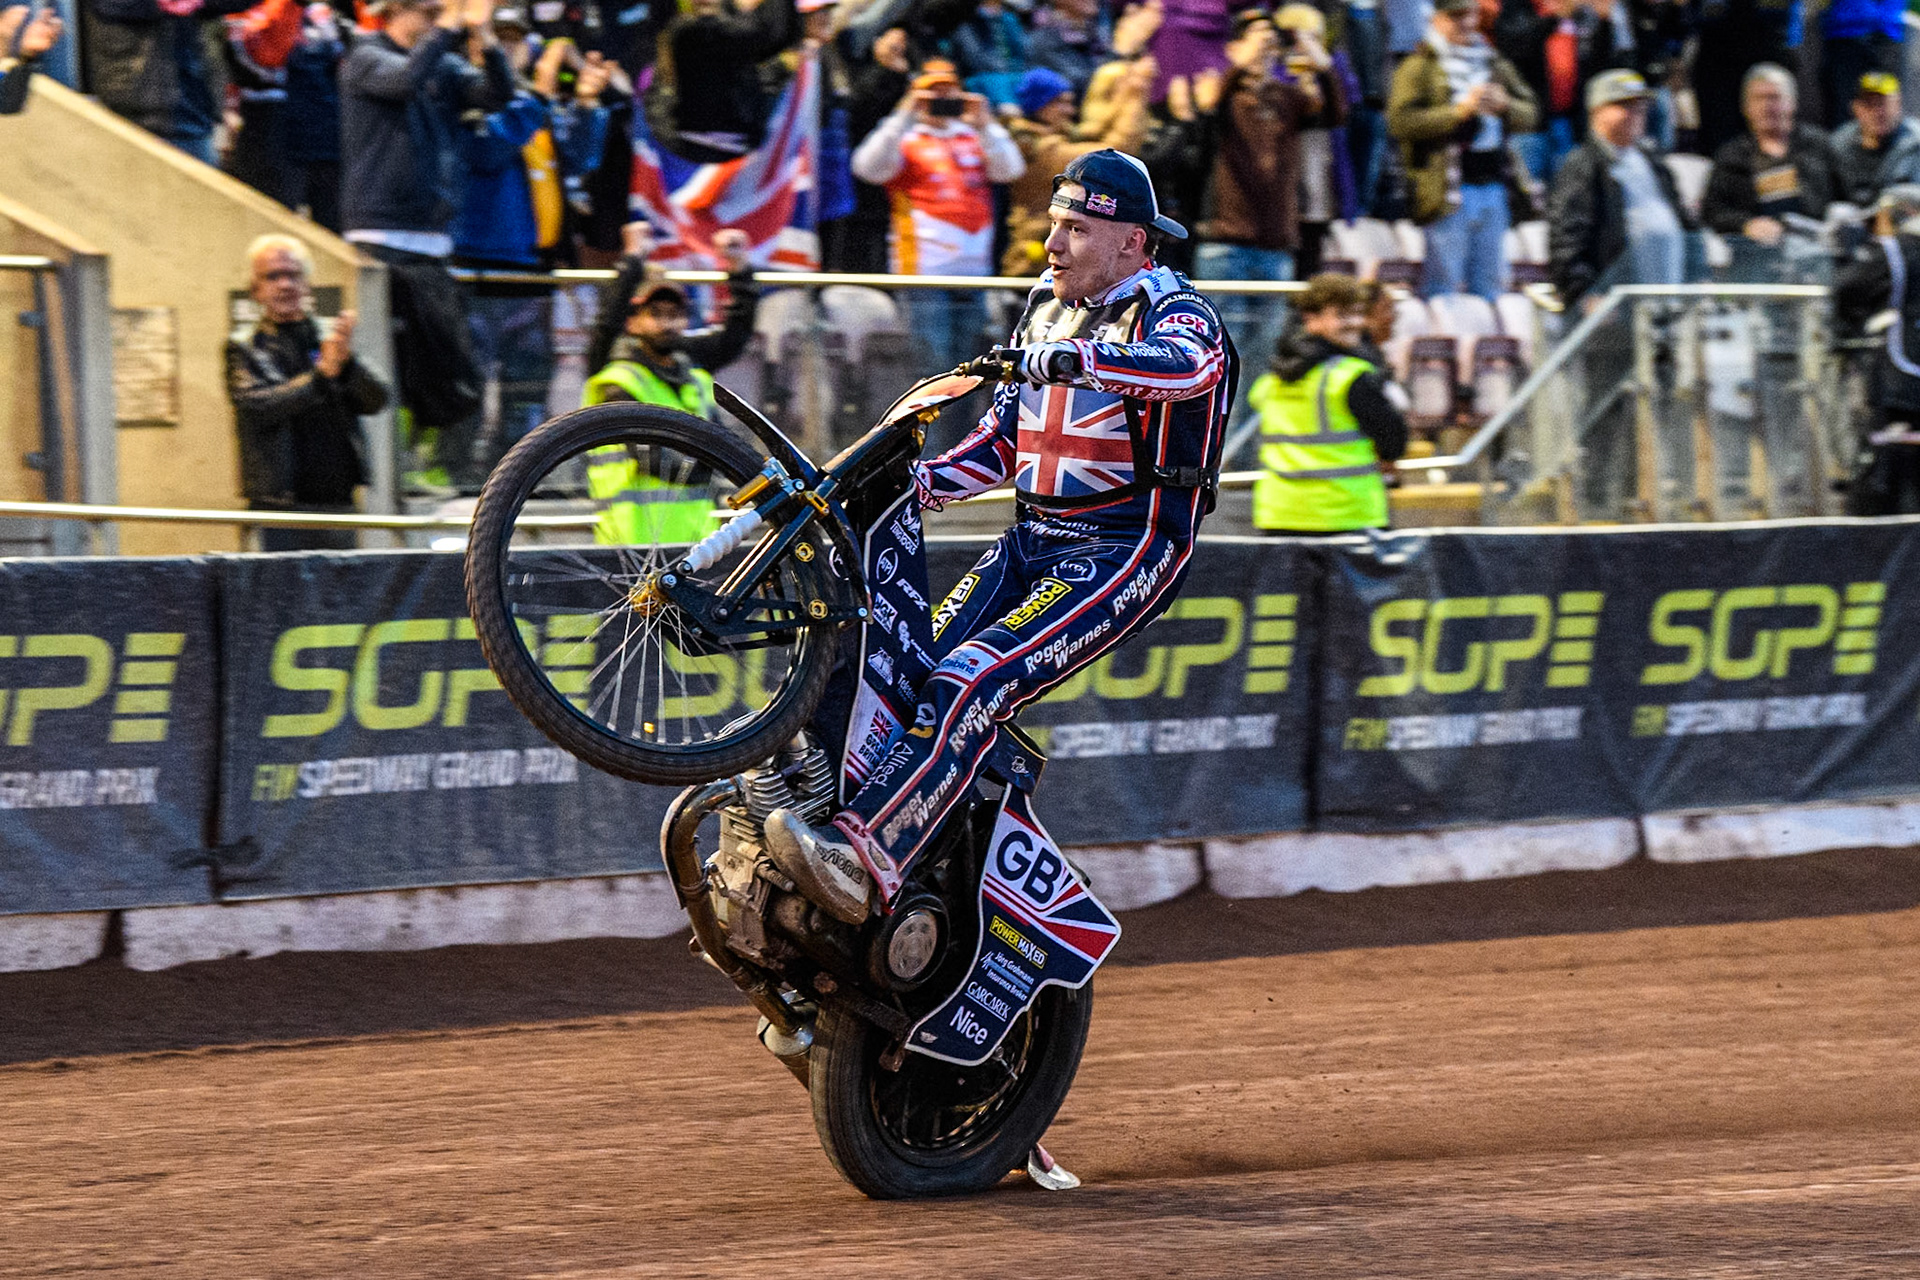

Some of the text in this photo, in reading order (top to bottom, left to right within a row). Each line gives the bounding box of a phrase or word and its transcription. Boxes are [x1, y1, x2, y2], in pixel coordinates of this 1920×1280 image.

[1126, 345, 1173, 359] Mobility
[1112, 566, 1149, 616] Roger
[1138, 540, 1175, 602] Warnes
[1004, 582, 1067, 627] POWER
[1025, 618, 1112, 674] Roger Warnes
[949, 697, 982, 755] Roger
[875, 742, 914, 787] Allied
[882, 790, 923, 848] Roger
[913, 763, 959, 827] Warnes
[996, 830, 1062, 905] GB
[992, 919, 1046, 965] POWER MAXED
[967, 981, 1012, 1019] GARCAREK
[949, 1005, 989, 1045] Nice
